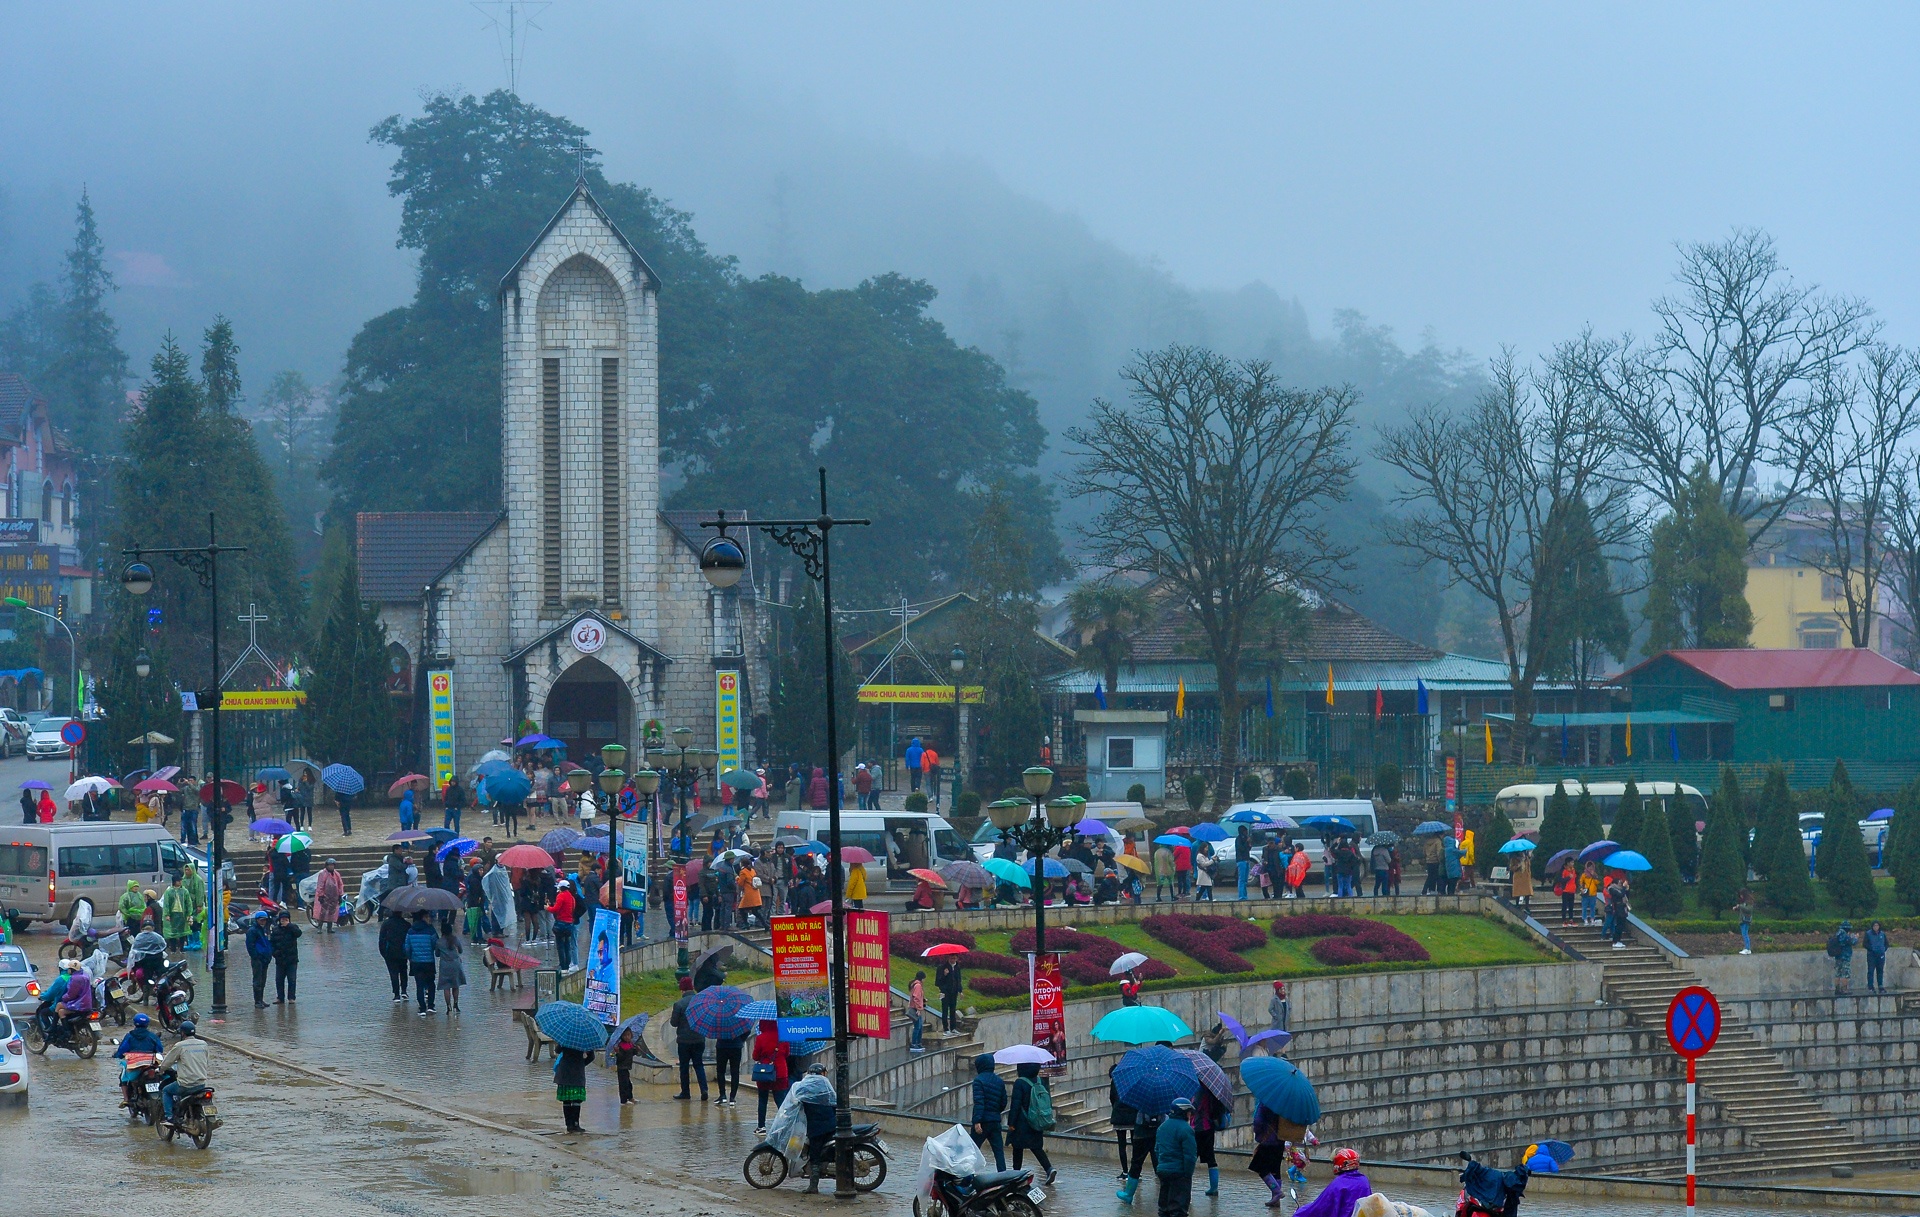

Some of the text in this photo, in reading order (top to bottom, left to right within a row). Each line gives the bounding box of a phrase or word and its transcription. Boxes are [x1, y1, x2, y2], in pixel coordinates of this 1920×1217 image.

[773, 922, 795, 931] KHÔNG
[788, 944, 805, 953] CÔNG
[787, 1025, 823, 1035] vinaphone
